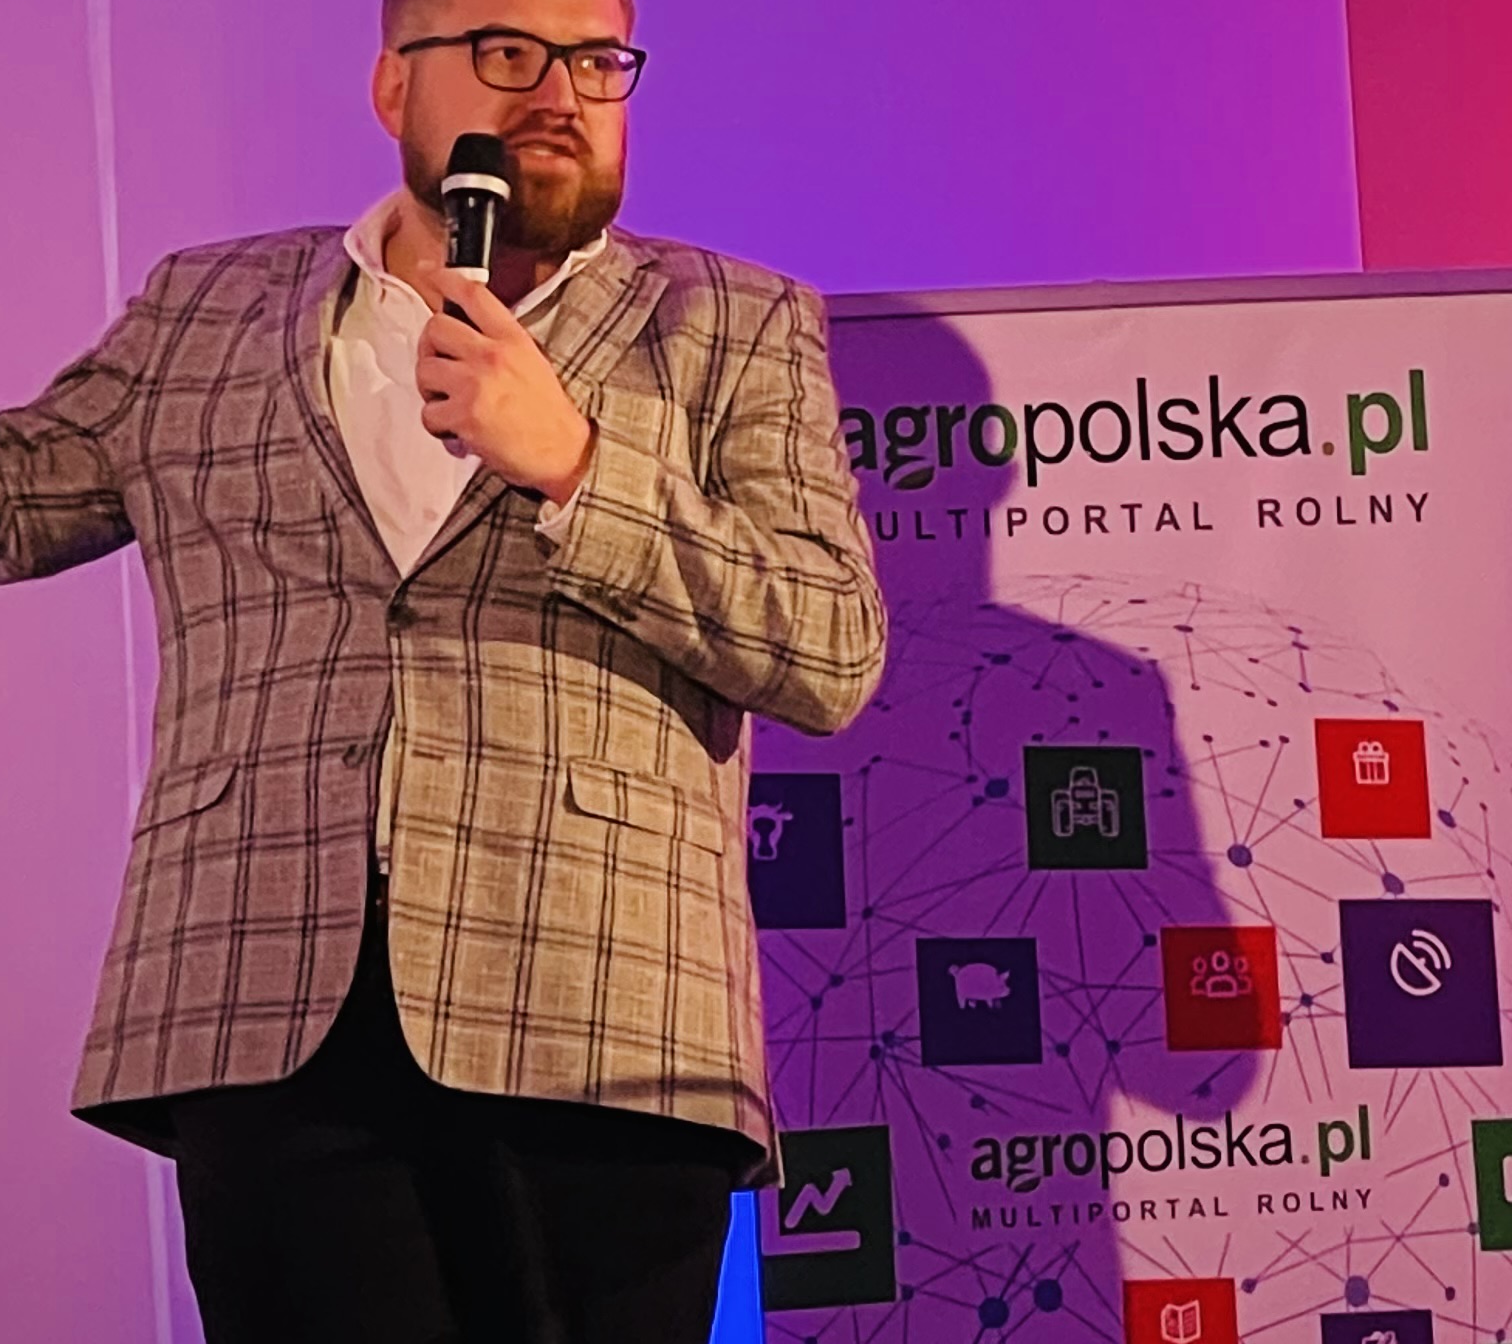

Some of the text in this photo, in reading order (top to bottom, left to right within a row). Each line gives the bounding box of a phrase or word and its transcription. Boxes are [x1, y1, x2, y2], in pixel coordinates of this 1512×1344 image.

[839, 368, 1429, 490] agropolska.pl
[875, 492, 1429, 541] ULTIPORTAL ROLNY
[970, 1104, 1372, 1193] agropolska.pl
[971, 1188, 1372, 1230] MULTIPORTAL ROLNY
